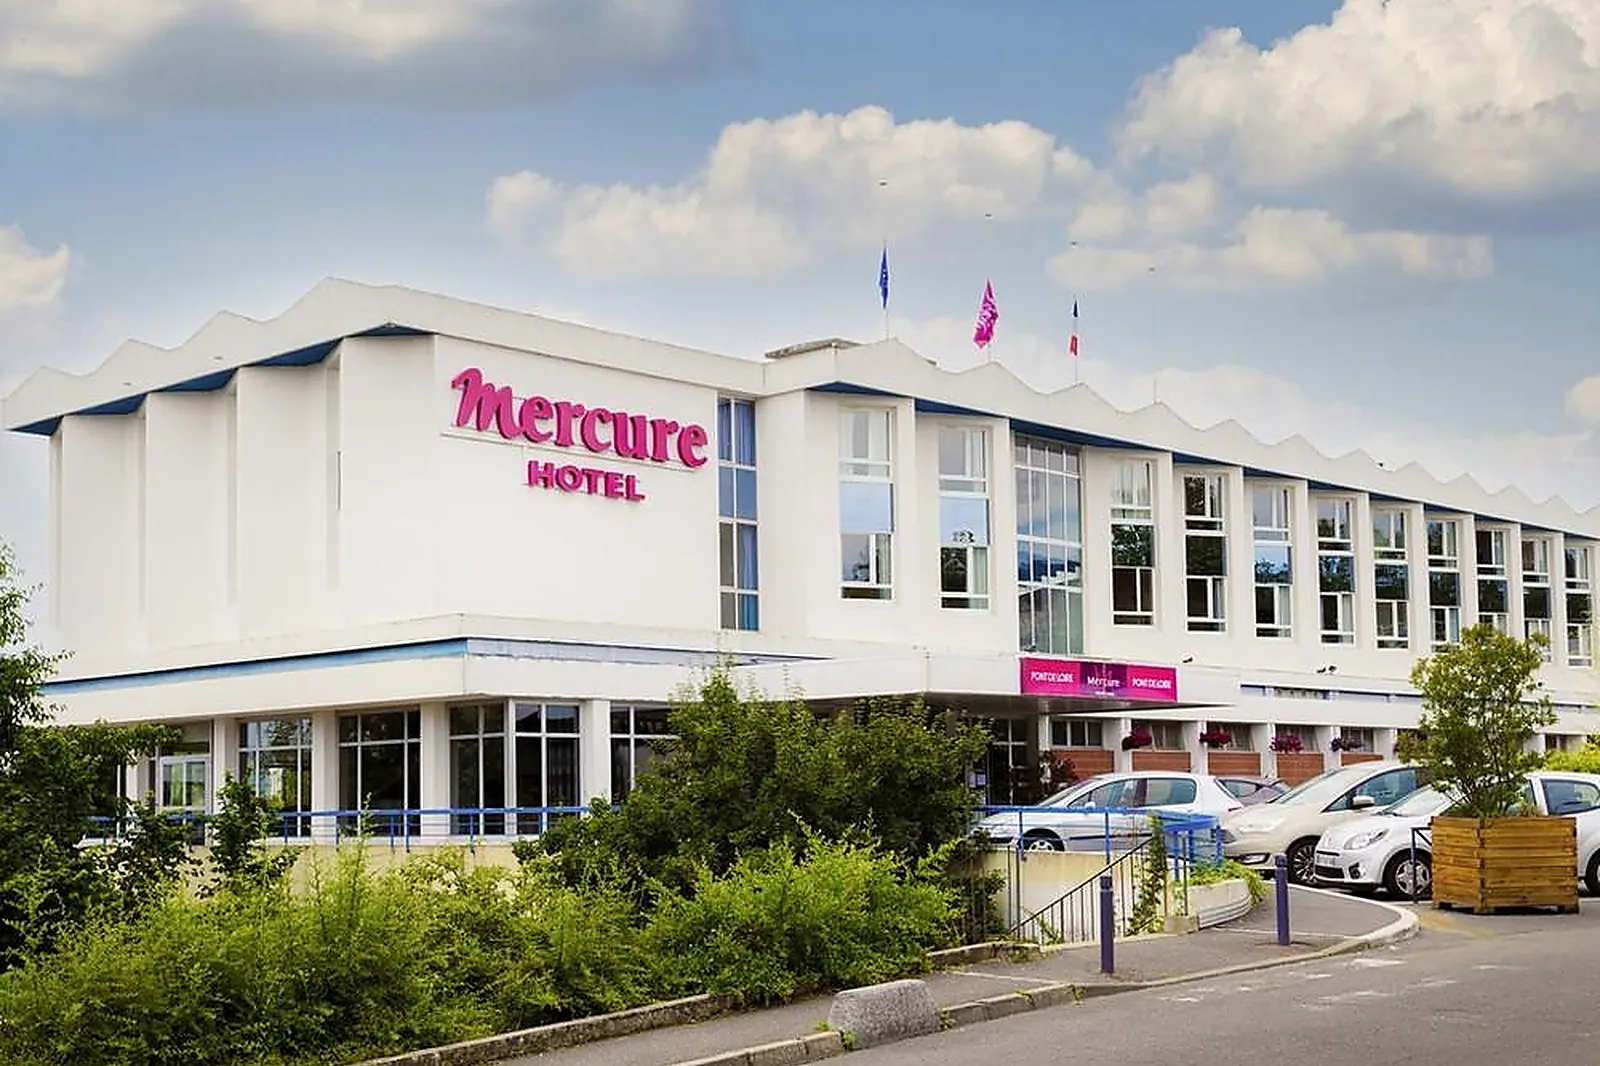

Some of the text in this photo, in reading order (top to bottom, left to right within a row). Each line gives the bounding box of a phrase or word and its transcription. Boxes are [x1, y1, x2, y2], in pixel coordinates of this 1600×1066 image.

[451, 367, 708, 468] Mercure
[527, 460, 645, 501] HOTEL
[1031, 671, 1047, 681] PONT
[1132, 678, 1148, 687] PONT
